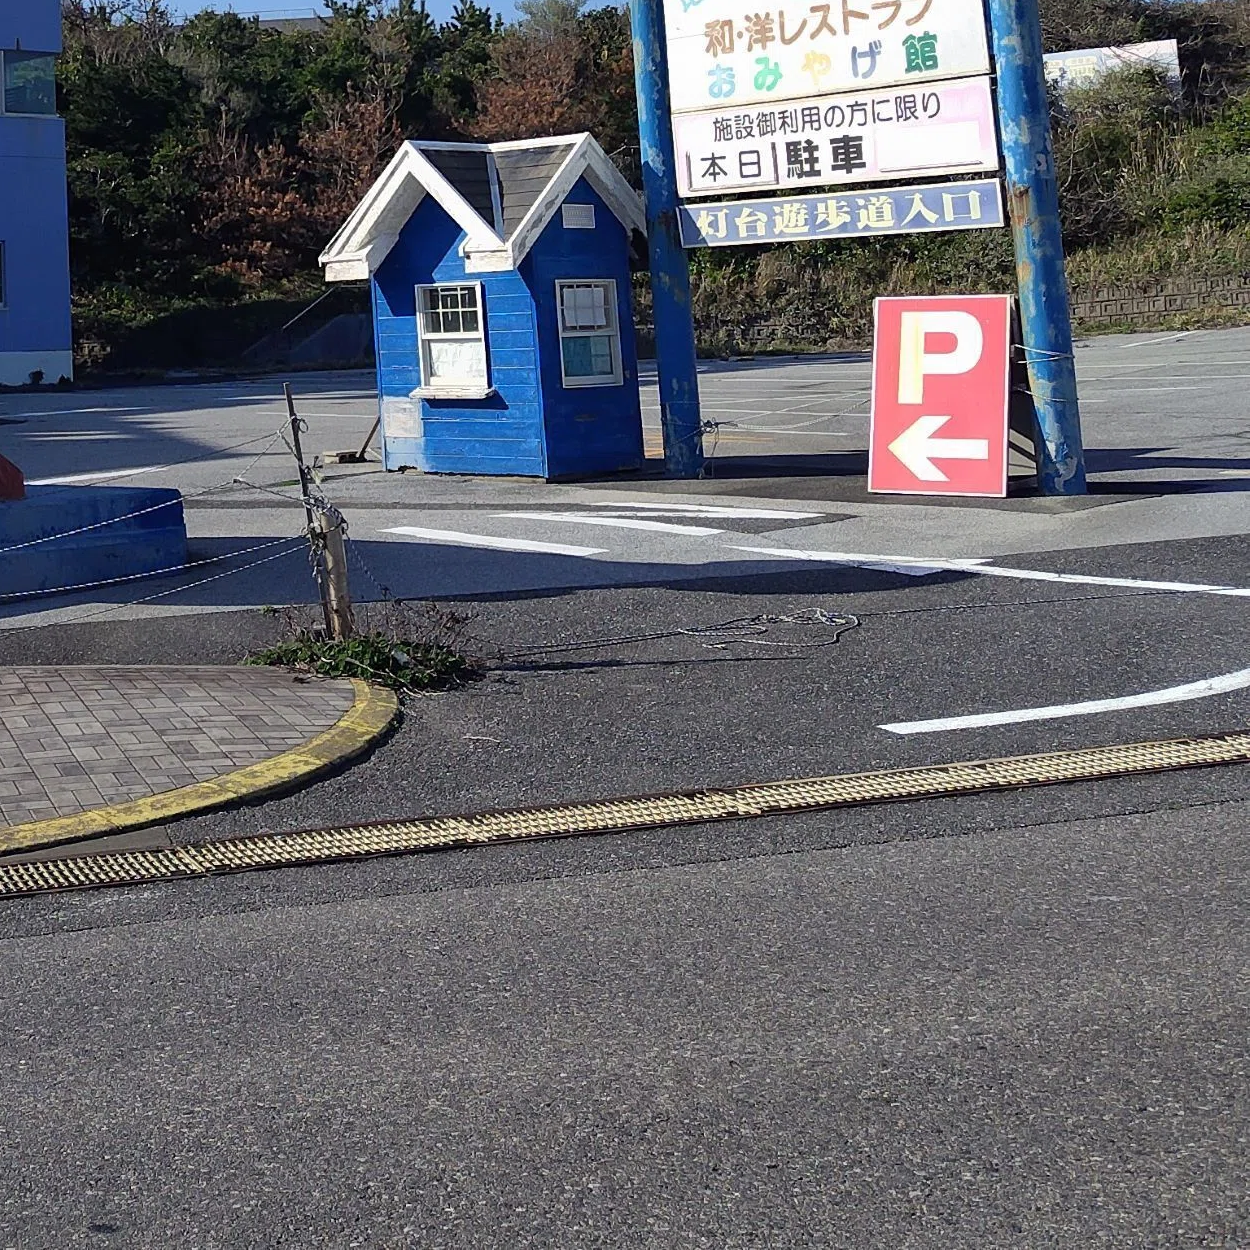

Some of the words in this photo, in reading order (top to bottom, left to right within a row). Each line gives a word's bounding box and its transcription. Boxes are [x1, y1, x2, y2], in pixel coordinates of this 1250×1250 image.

[708, 31, 938, 98] おみやげ館
[713, 92, 941, 142] 施設御利用の方に限り
[701, 150, 762, 182] 本日
[785, 135, 867, 179] 駐車
[696, 190, 981, 239] 灯台遊歩道入口
[898, 311, 983, 404] P
